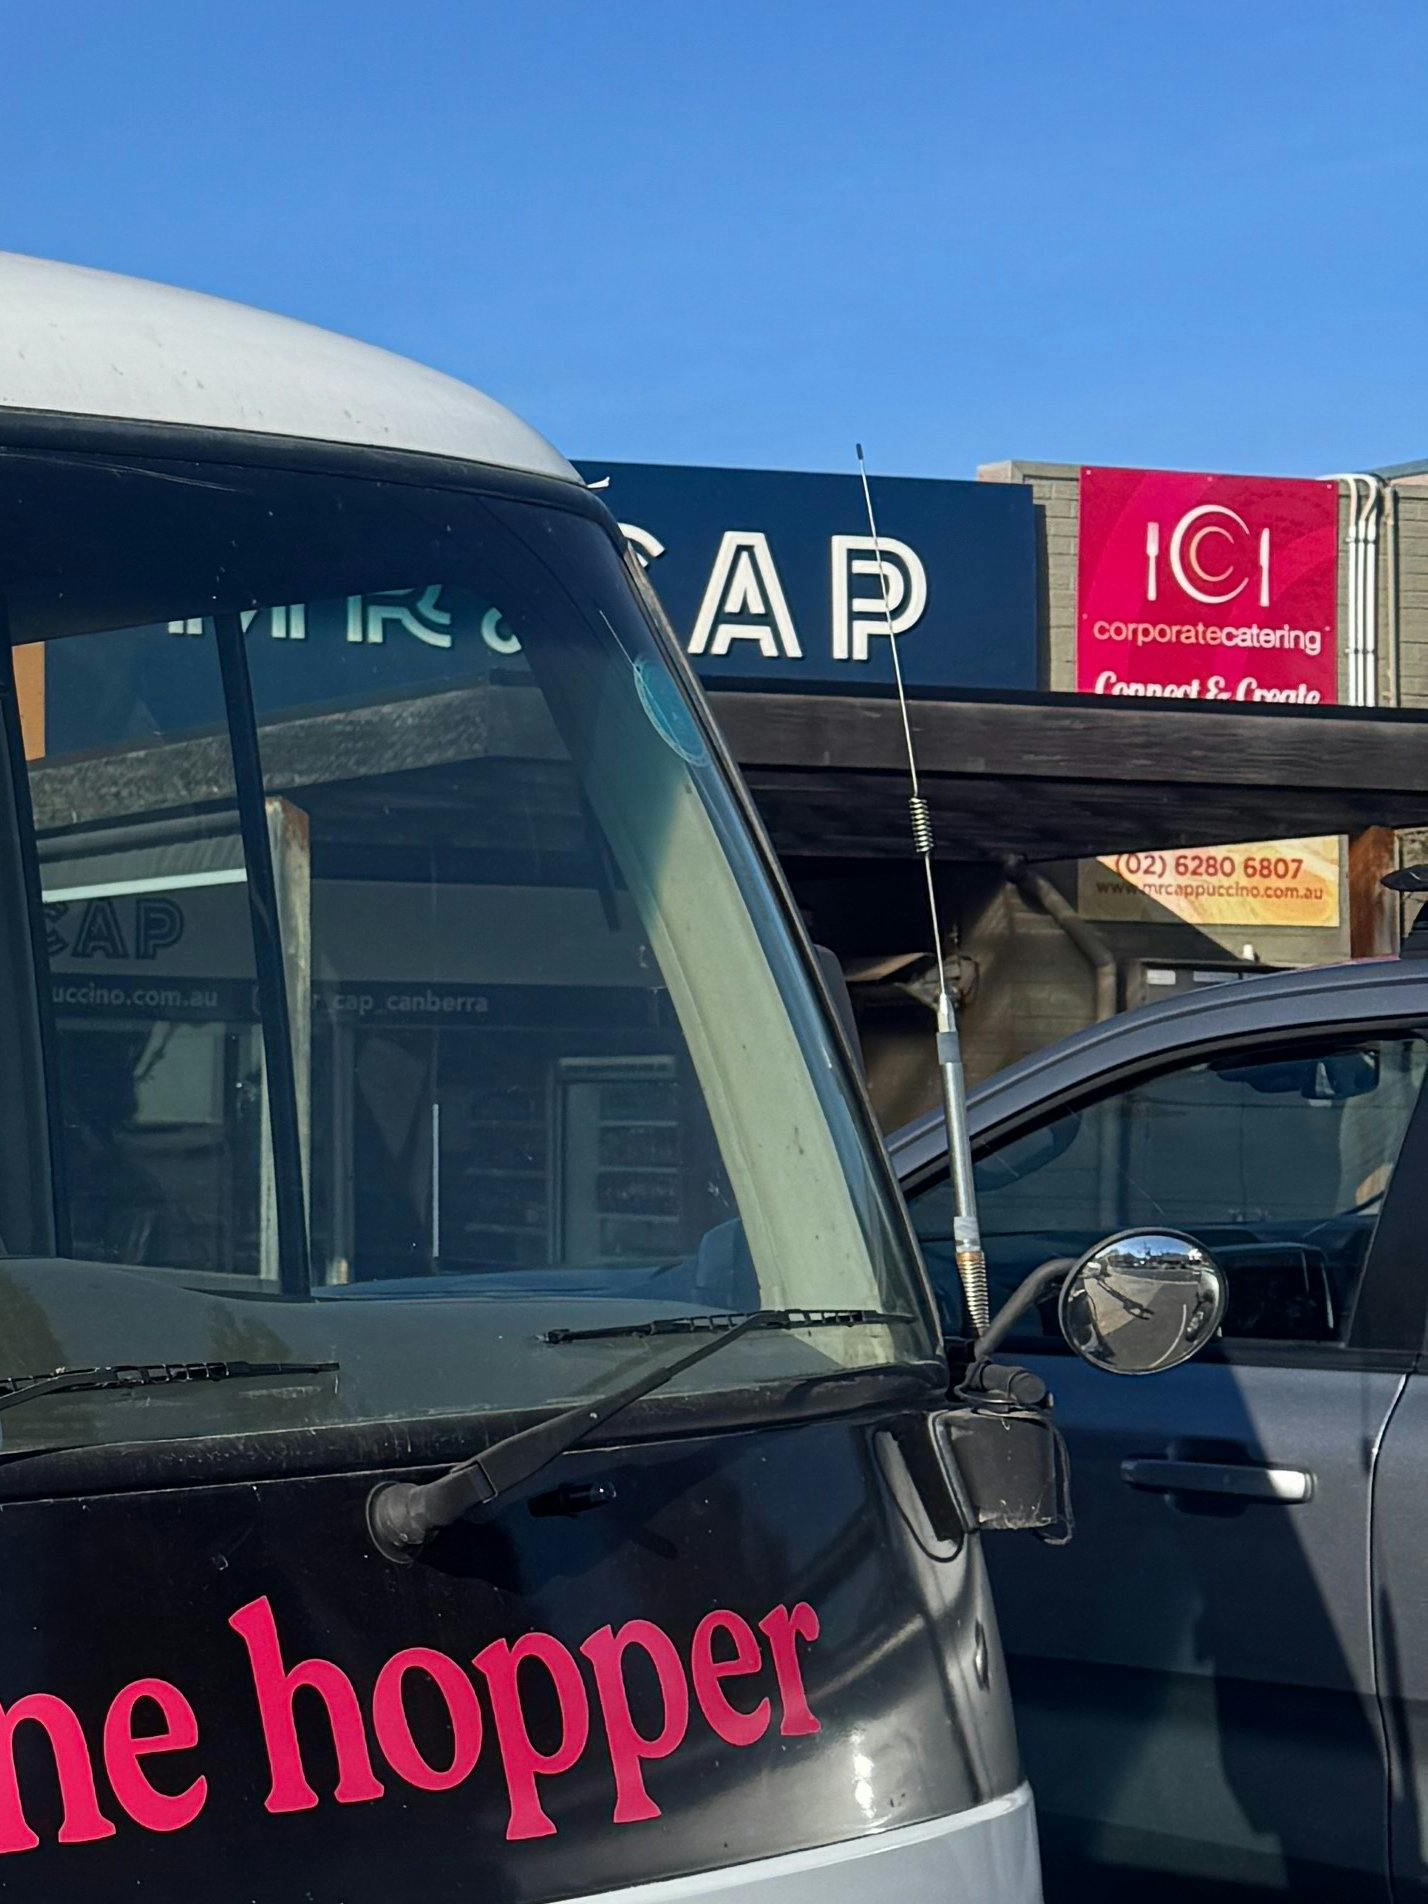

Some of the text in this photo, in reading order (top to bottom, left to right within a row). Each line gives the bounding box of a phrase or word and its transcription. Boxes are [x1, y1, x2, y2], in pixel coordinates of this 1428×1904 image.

[1092, 619, 1322, 656] corporatecatering
[1115, 852, 1304, 880] (02) 6280 6807
[52, 981, 218, 1008] uccino.com.au
[228, 1595, 820, 1840] hopper
